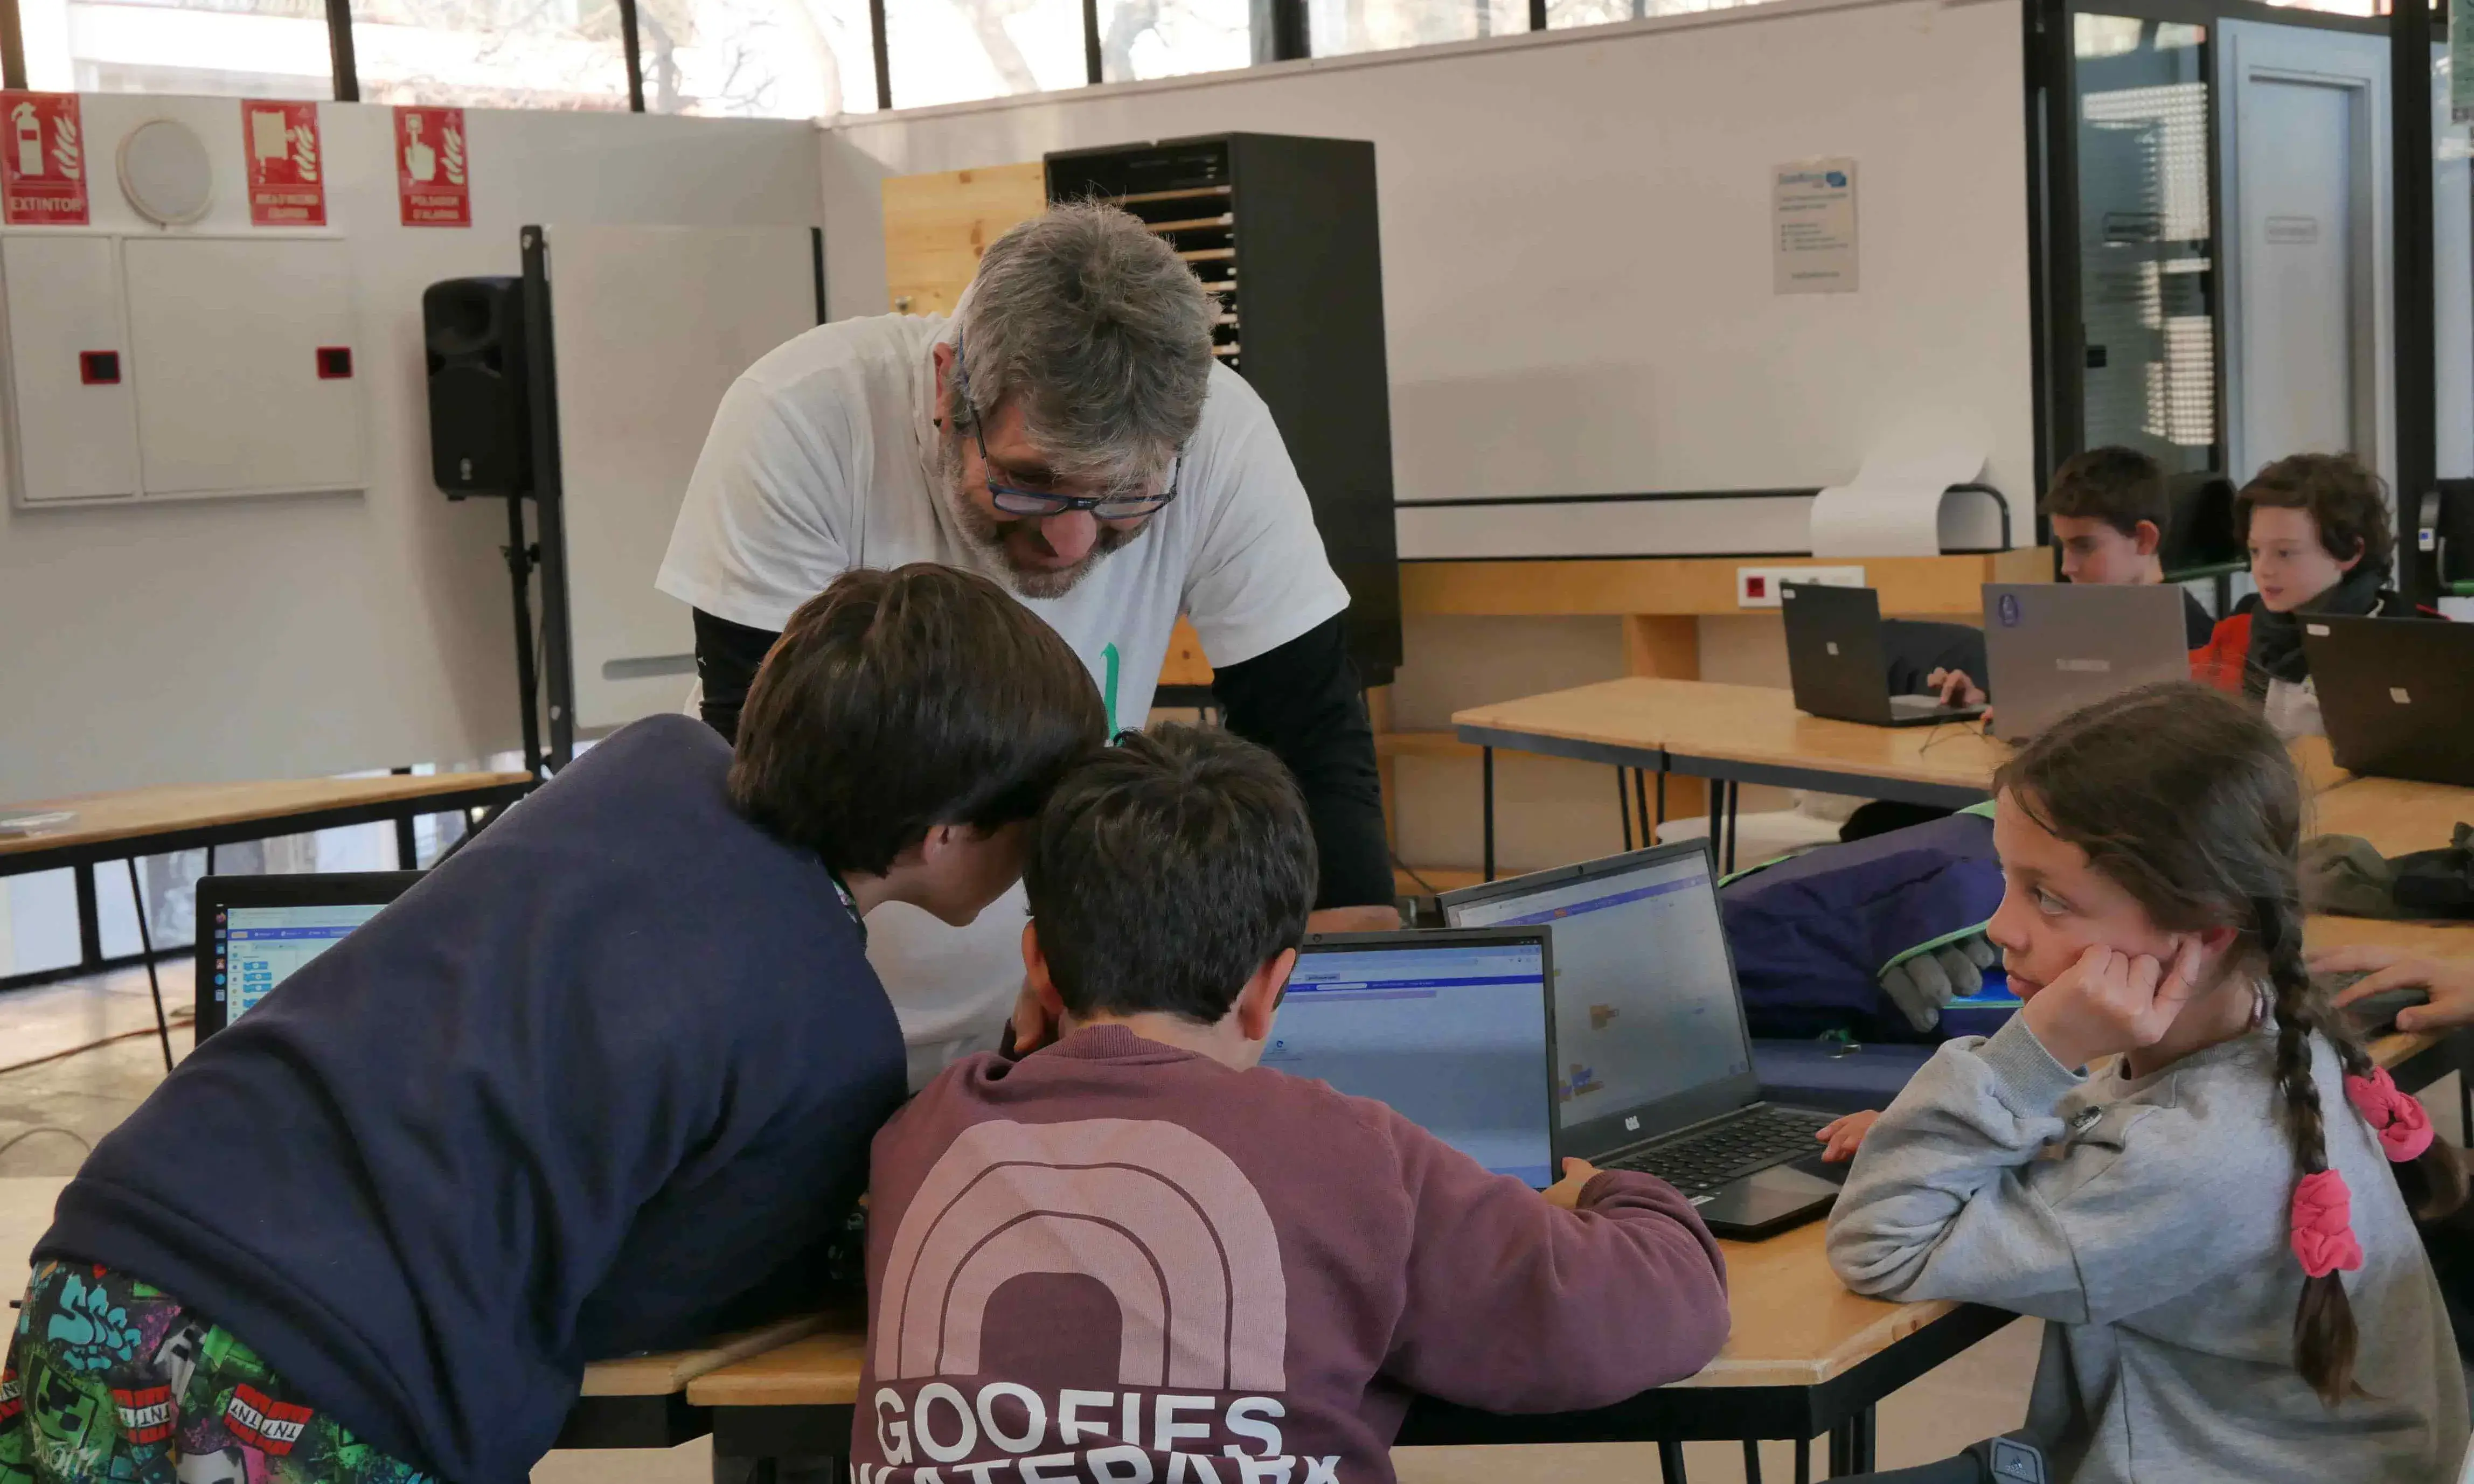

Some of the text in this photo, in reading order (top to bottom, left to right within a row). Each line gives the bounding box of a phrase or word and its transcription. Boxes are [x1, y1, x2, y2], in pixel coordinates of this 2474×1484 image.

[10, 197, 83, 212] EXTINTOR
[230, 1403, 296, 1439] TNT TNT
[874, 1382, 1286, 1466] GOOFIES
